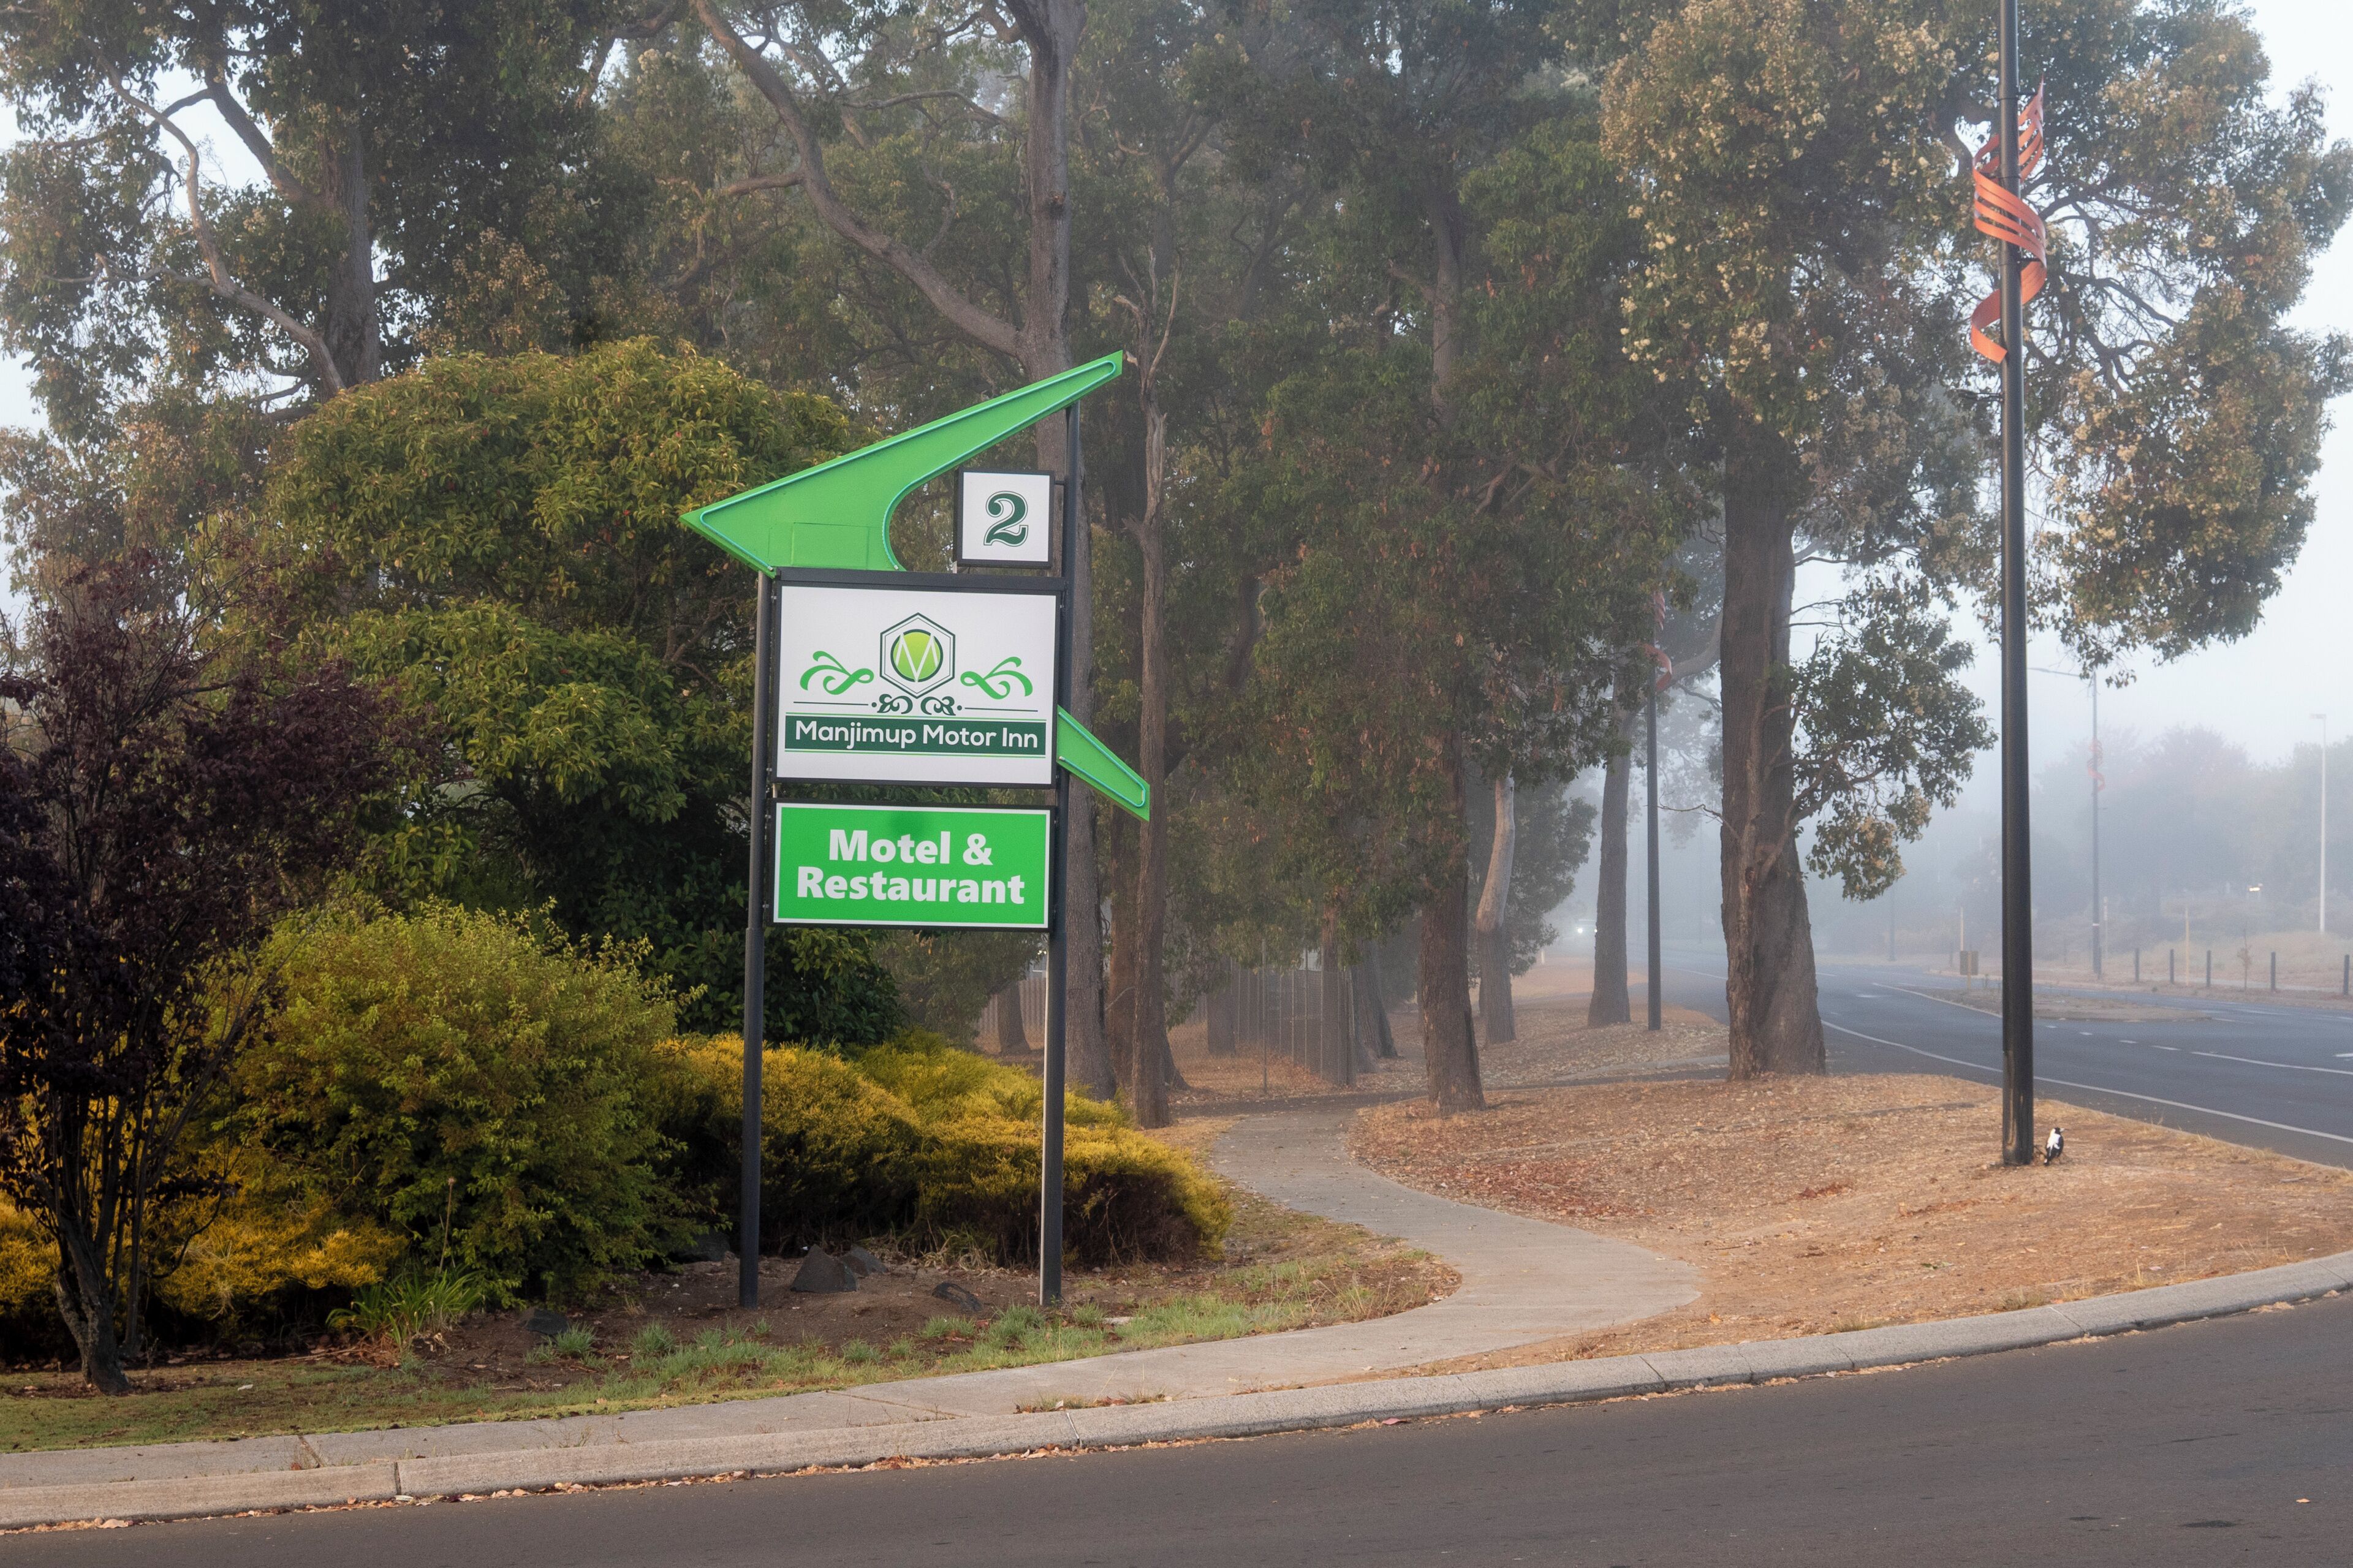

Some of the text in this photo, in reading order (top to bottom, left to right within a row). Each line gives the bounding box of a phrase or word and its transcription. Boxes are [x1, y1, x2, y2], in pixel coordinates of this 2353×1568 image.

[983, 490, 1029, 547] 2
[795, 721, 1038, 750] Manjimup Motor Inn
[829, 829, 993, 866] Motel &
[797, 866, 1025, 904] Restaurant
